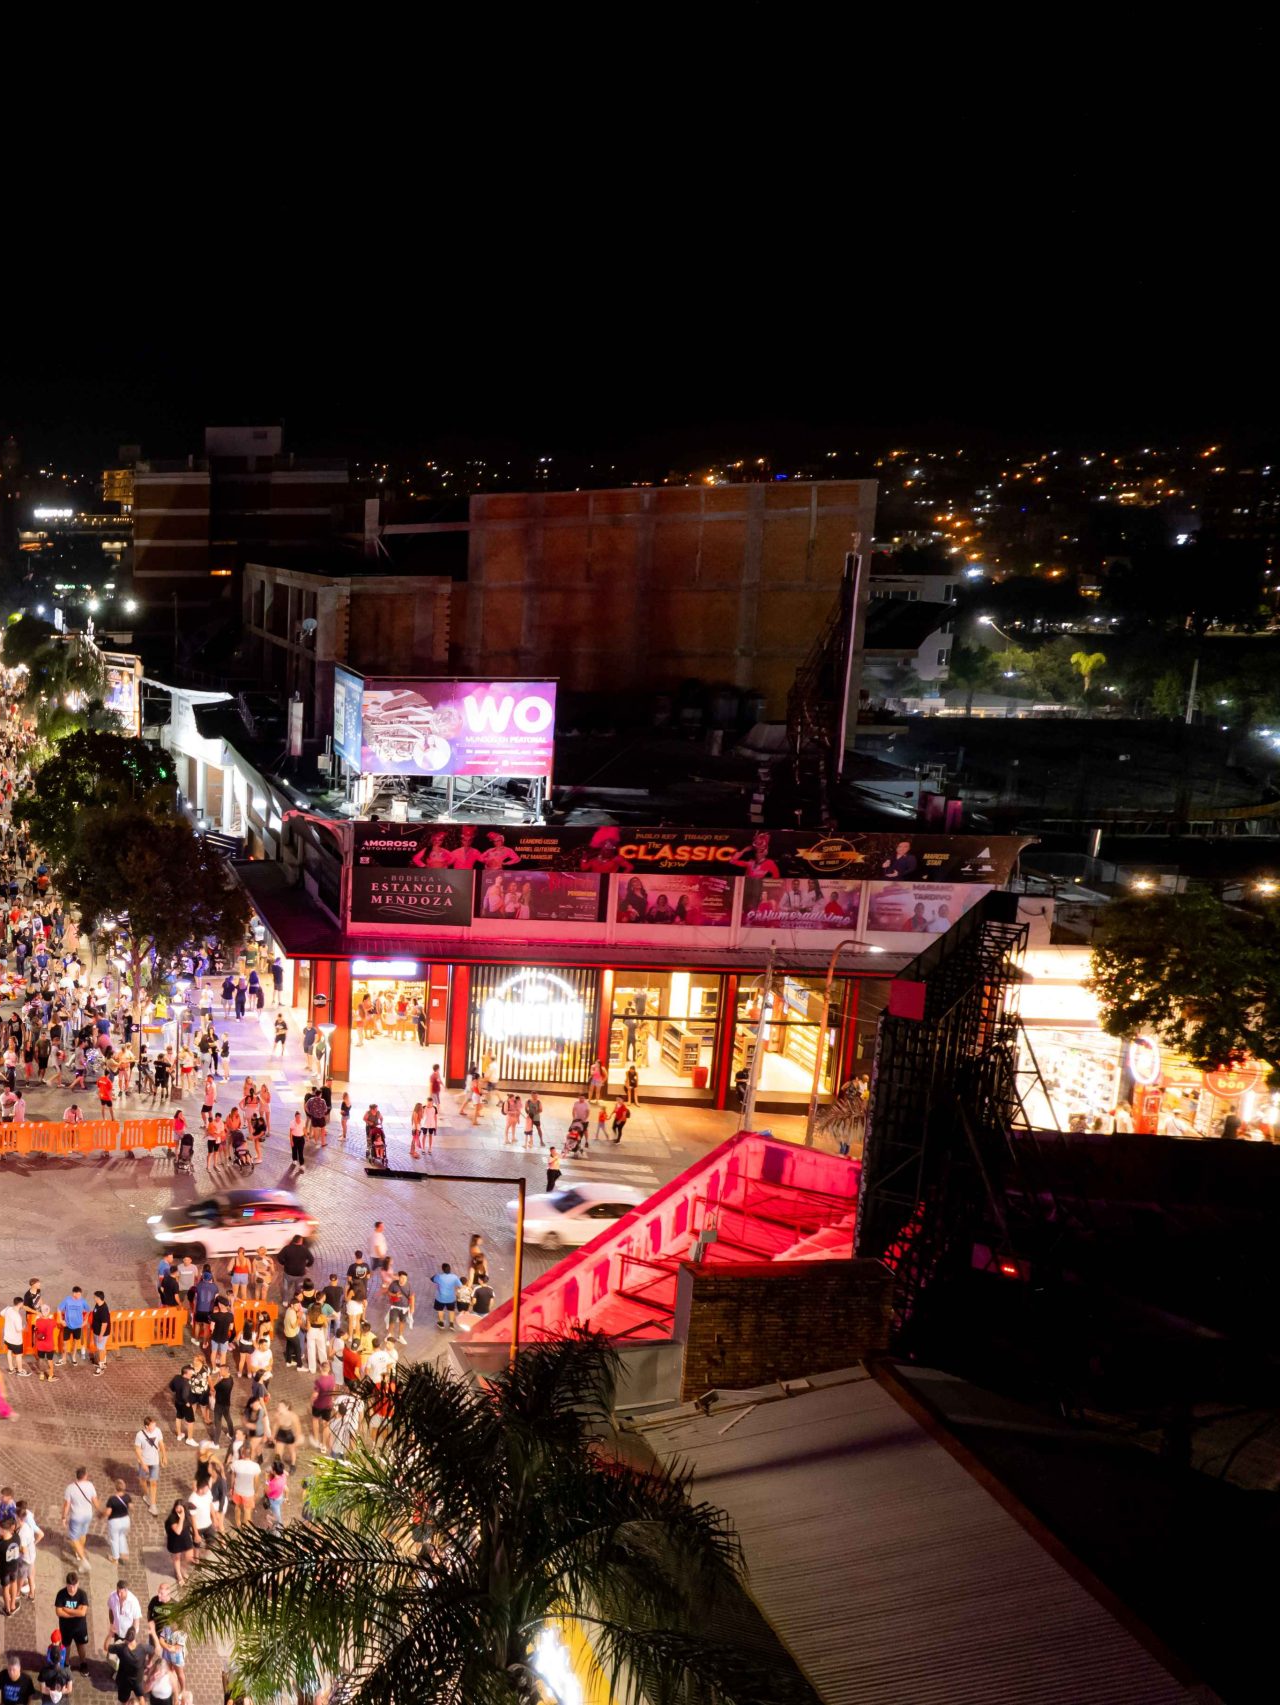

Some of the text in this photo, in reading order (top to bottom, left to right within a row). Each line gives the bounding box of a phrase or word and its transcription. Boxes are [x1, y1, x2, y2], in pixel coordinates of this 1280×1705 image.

[463, 695, 553, 734] WO
[648, 841, 662, 849] The
[619, 843, 738, 862] CLASSIC
[659, 859, 688, 868] show
[391, 874, 435, 883] BODEGA
[370, 882, 454, 895] ESTANCIA
[370, 895, 453, 907] MENDOZA
